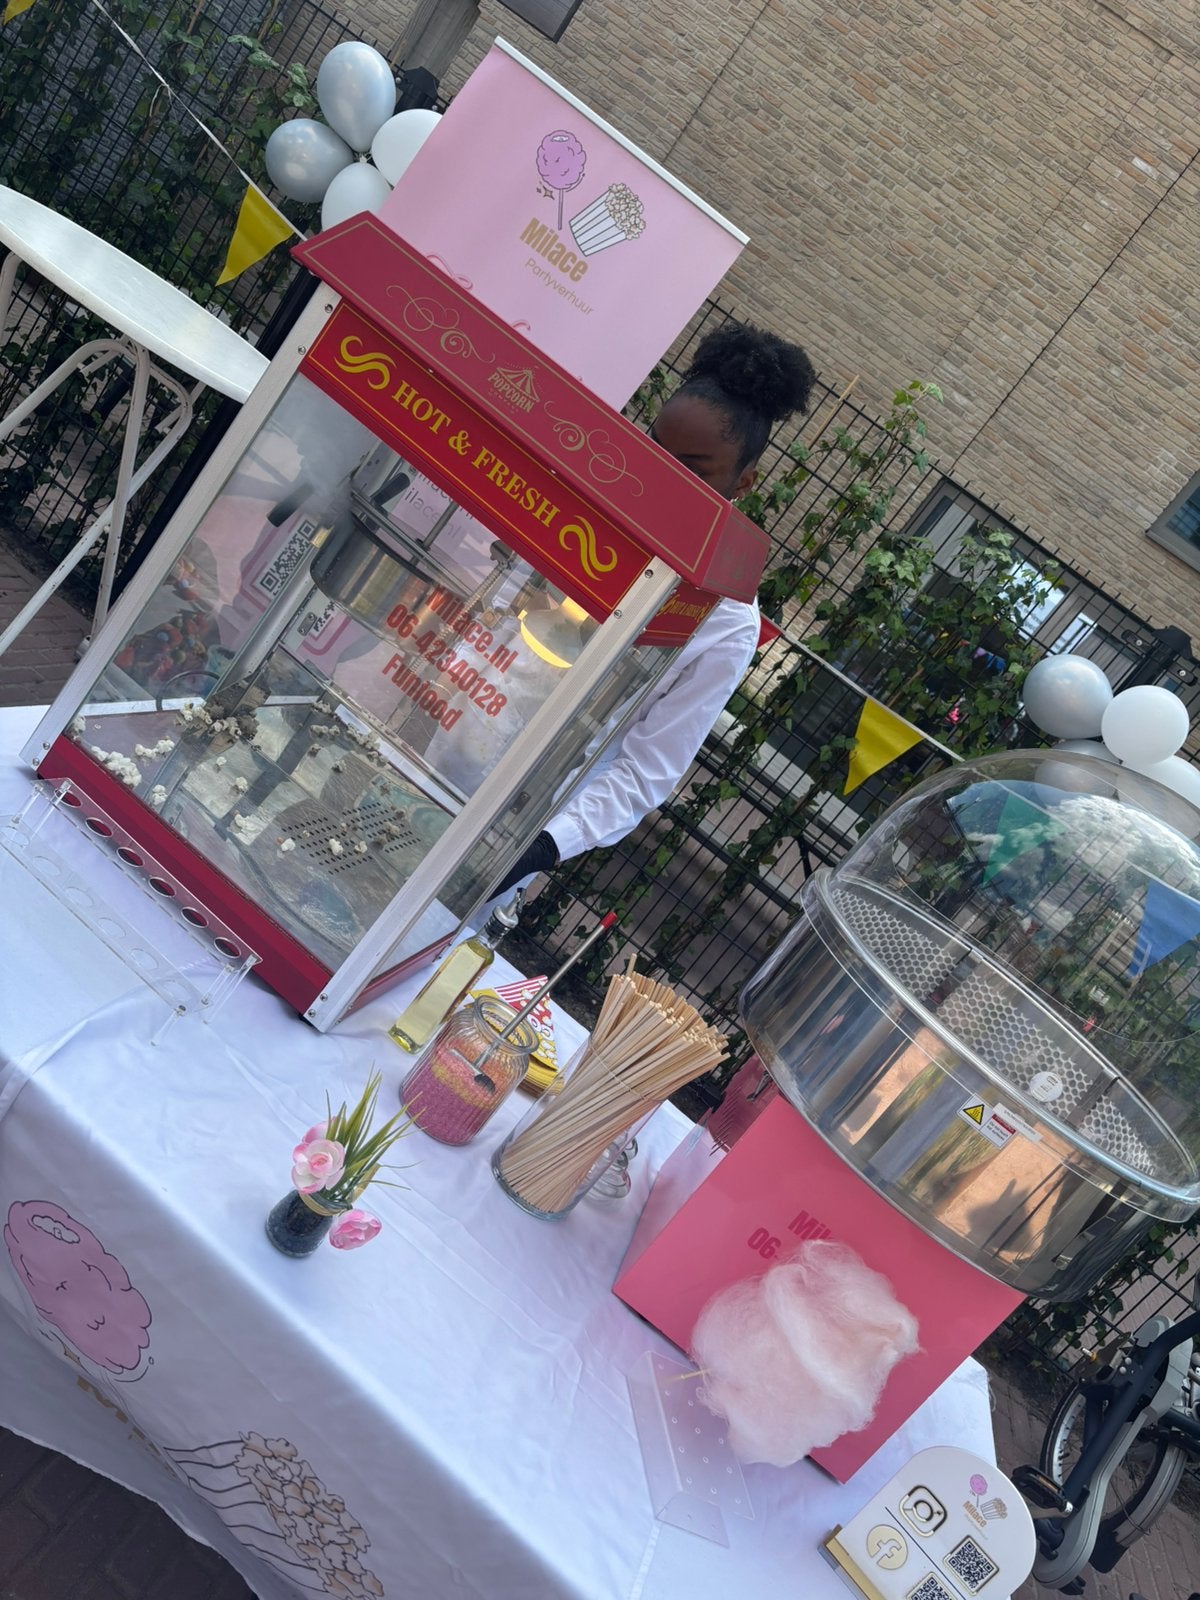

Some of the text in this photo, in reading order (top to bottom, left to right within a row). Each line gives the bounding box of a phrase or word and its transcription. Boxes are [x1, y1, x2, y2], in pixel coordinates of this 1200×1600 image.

[519, 217, 589, 282] Milace
[525, 257, 595, 316] Partyverhuur
[488, 372, 535, 413] POPCORN
[391, 380, 452, 435] HOT
[448, 430, 472, 456] &
[471, 446, 561, 528] FRESH
[386, 604, 508, 718] 06-42340128
[425, 584, 519, 674] Milace.nl
[963, 1500, 987, 1528] Milace
